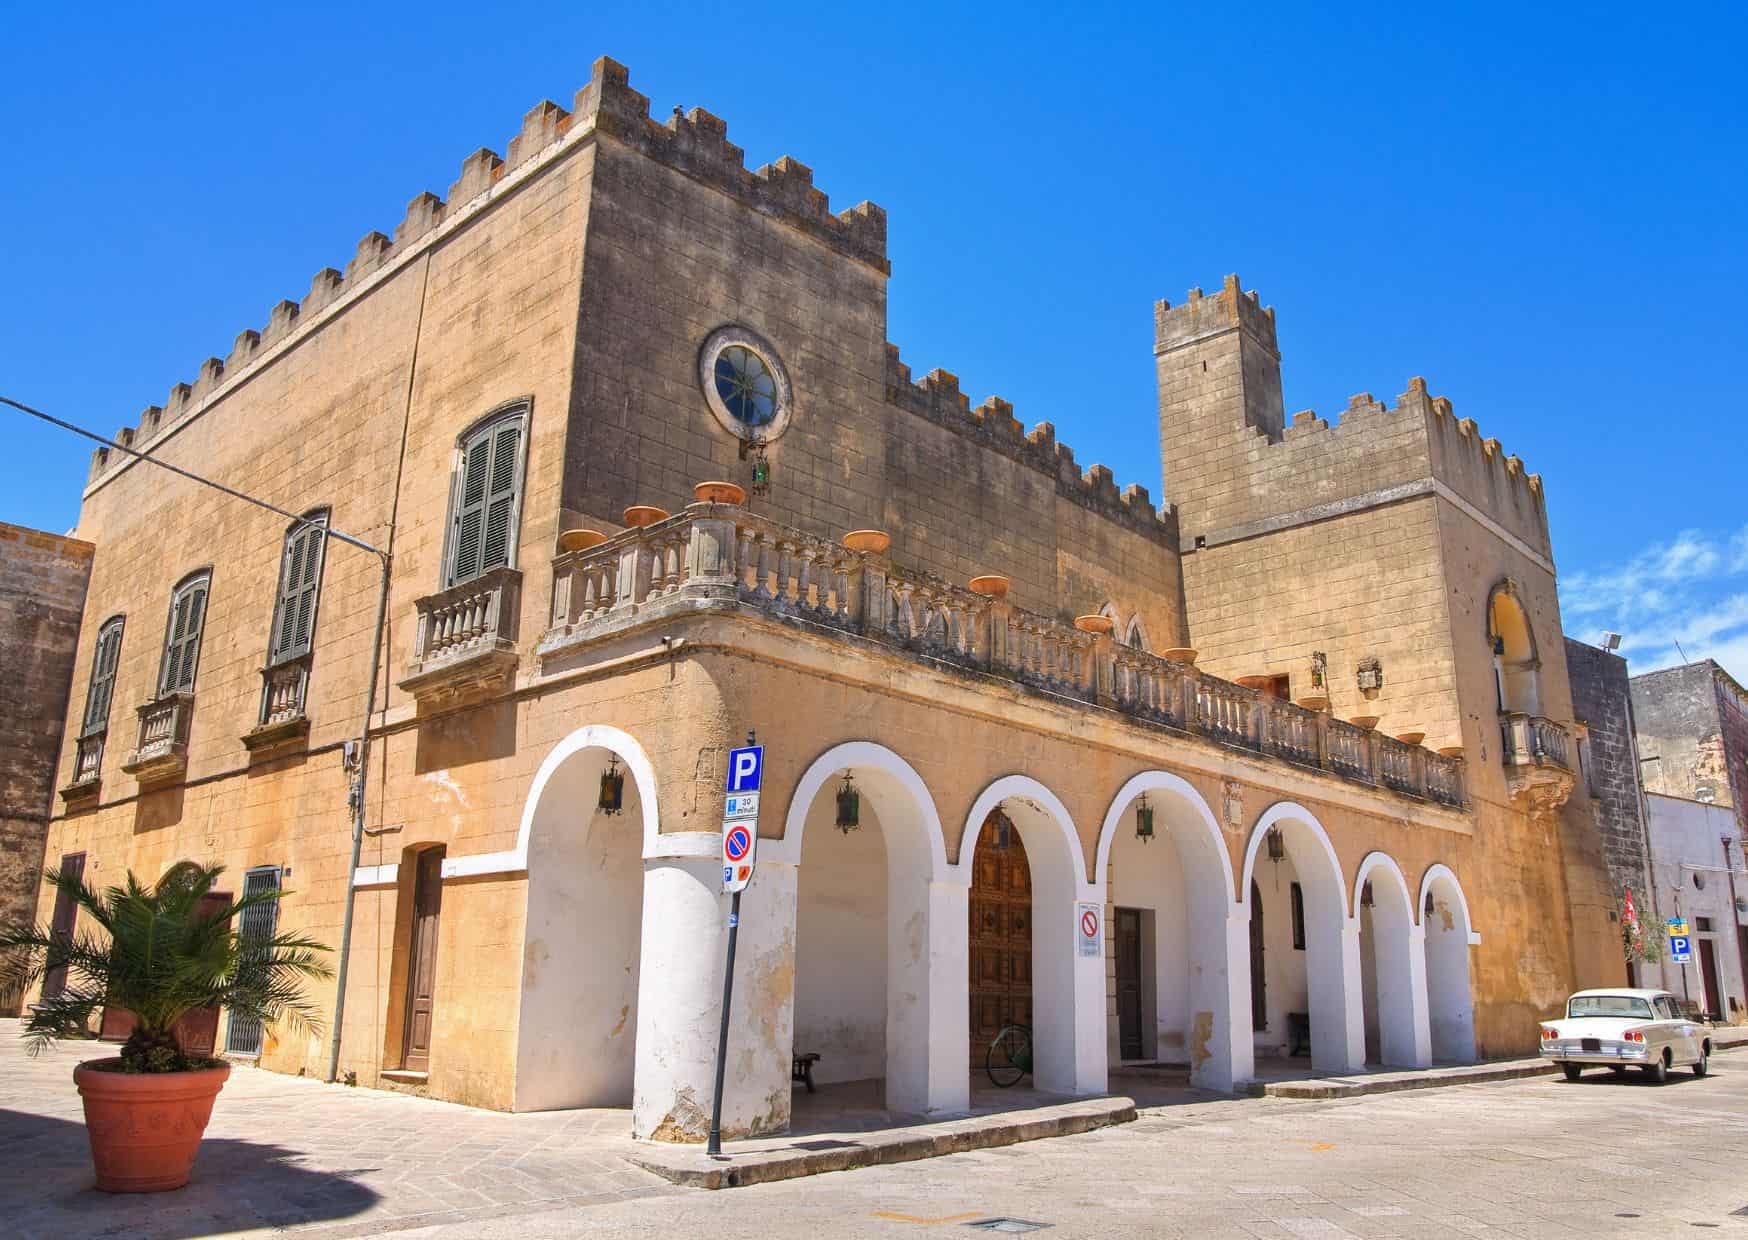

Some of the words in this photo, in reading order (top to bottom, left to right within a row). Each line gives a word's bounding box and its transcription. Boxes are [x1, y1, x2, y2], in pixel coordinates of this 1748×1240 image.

[734, 752, 757, 790] P
[725, 869, 731, 880] P
[1674, 939, 1686, 953] P
